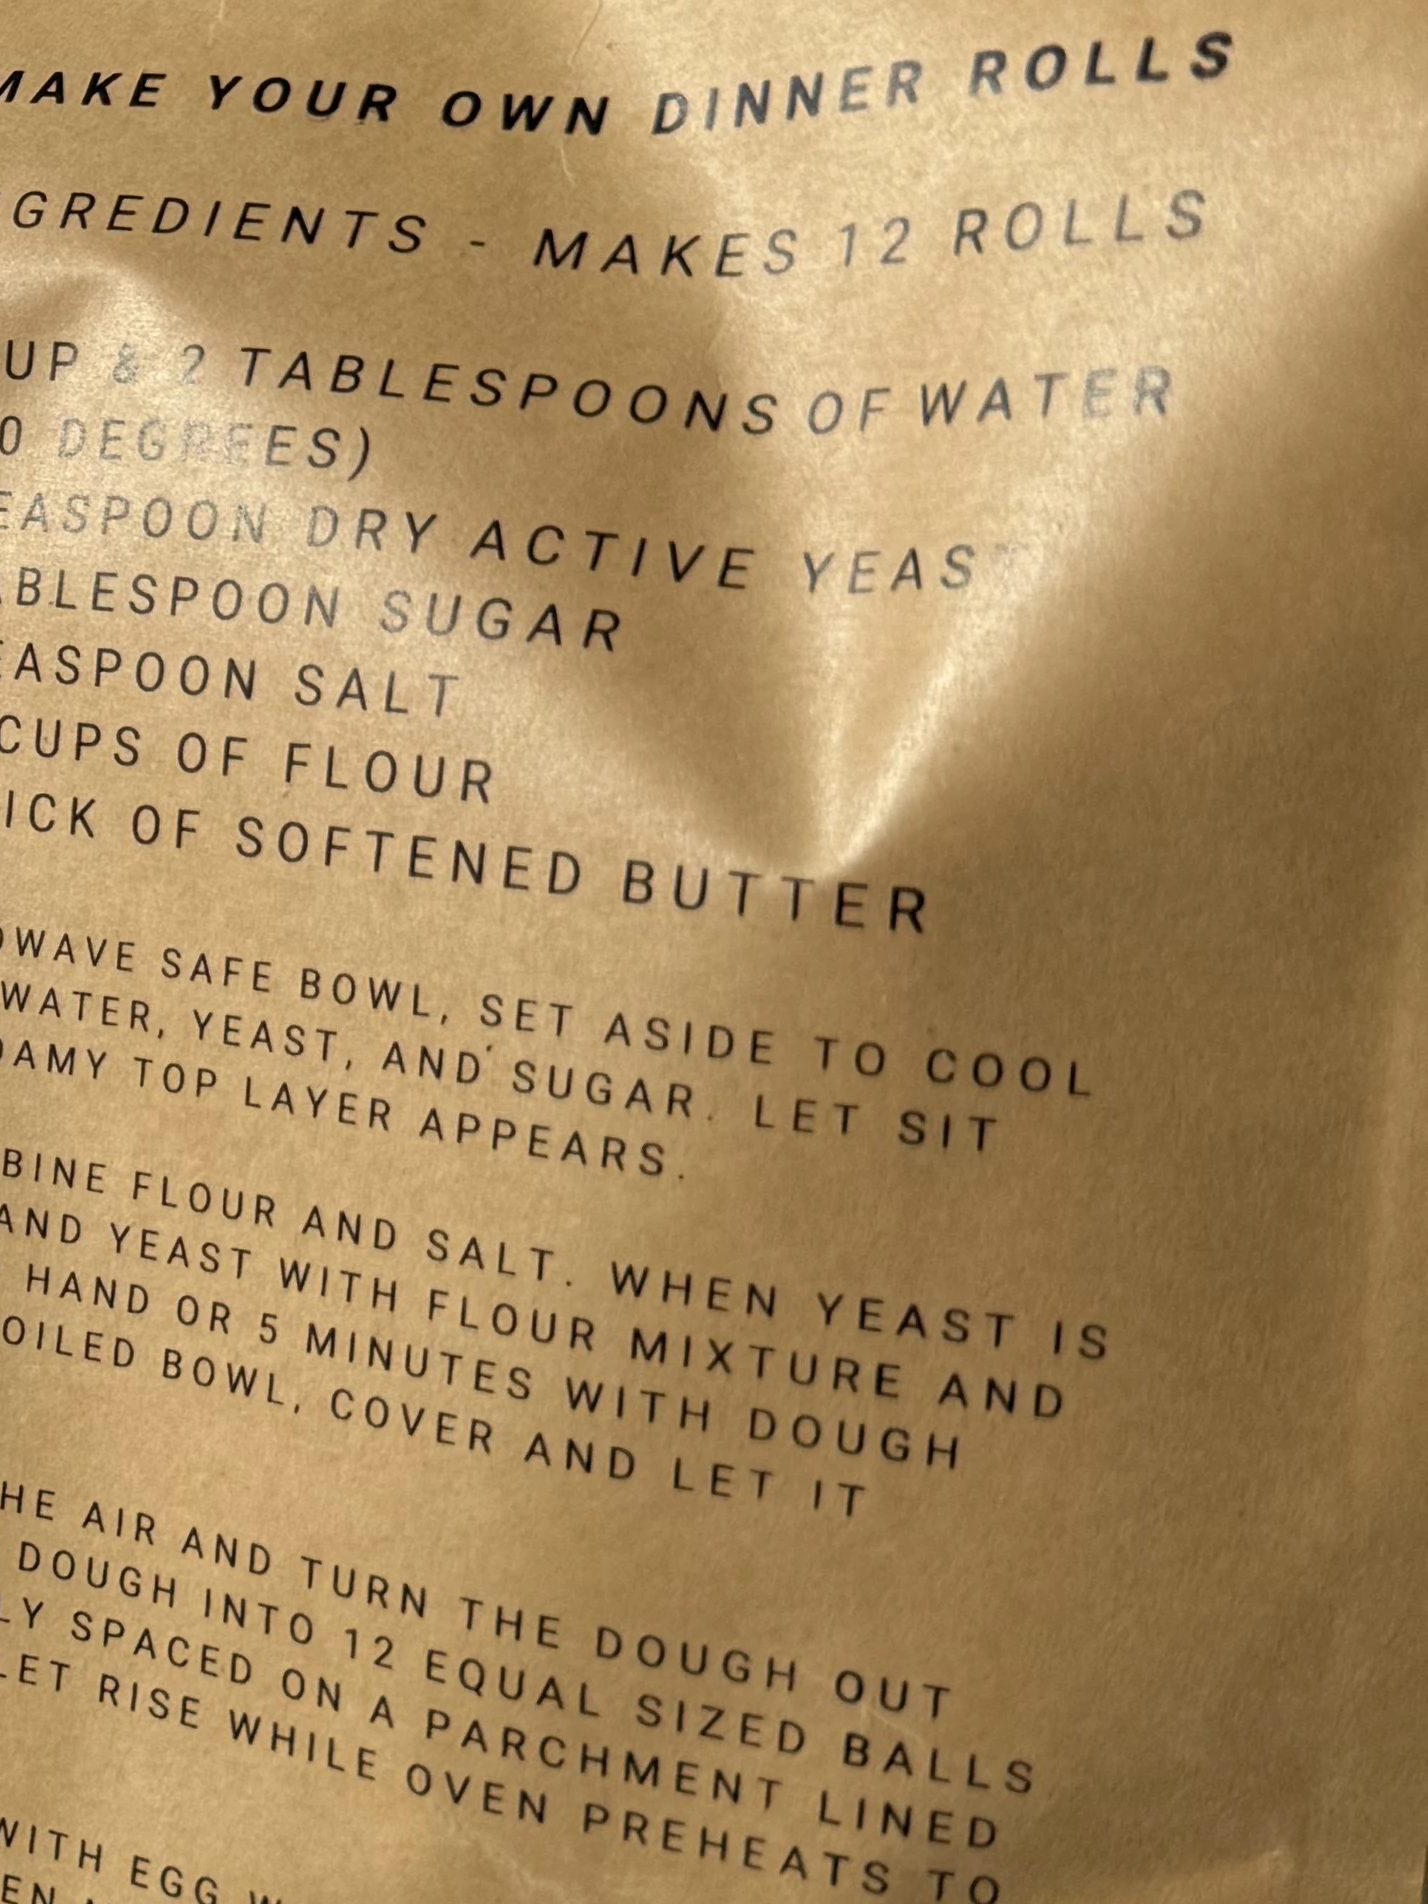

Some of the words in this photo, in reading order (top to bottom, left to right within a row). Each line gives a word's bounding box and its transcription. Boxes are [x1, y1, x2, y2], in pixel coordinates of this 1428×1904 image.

[209, 74, 399, 126] YOUR
[439, 89, 611, 137] OWN
[651, 59, 923, 136] DINNER
[968, 30, 1234, 99] ROLLS
[532, 227, 798, 278] MAKES
[839, 216, 910, 268] 12
[953, 188, 1206, 257] ROLLS
[179, 342, 206, 386] 2
[240, 346, 778, 437] TABLESPOONS
[808, 386, 891, 436] OF
[921, 366, 1171, 428] WATER
[307, 504, 438, 554] DRY
[469, 519, 756, 591] ACTIVE
[803, 541, 1034, 596] YEAS
[379, 590, 622, 653] SUGAR
[294, 663, 459, 718] SALT
[177, 731, 248, 777] OF
[285, 741, 493, 806] FLOUR
[131, 803, 201, 850] OF
[235, 815, 582, 896] SOFTENED
[622, 859, 927, 936] BUTTER
[161, 947, 272, 993] SAFE
[479, 993, 574, 1040] SET
[603, 1011, 774, 1066] ASIDE
[814, 1036, 887, 1078] TO
[925, 1047, 1092, 1099] COOL
[133, 1056, 218, 1099] TOP
[244, 1076, 391, 1132] LAYER
[132, 1170, 276, 1228] FLOUR
[301, 1204, 397, 1252] AND
[611, 1260, 777, 1320] WHEN
[816, 1291, 1016, 1350] YEAST
[1053, 1319, 1108, 1362] IS
[81, 1500, 156, 1546] AIR
[180, 1526, 272, 1577] AND
[300, 1555, 427, 1620] TURN
[459, 1596, 561, 1650] THE
[595, 1625, 797, 1693] DOUGH
[834, 1669, 951, 1722] OUT
